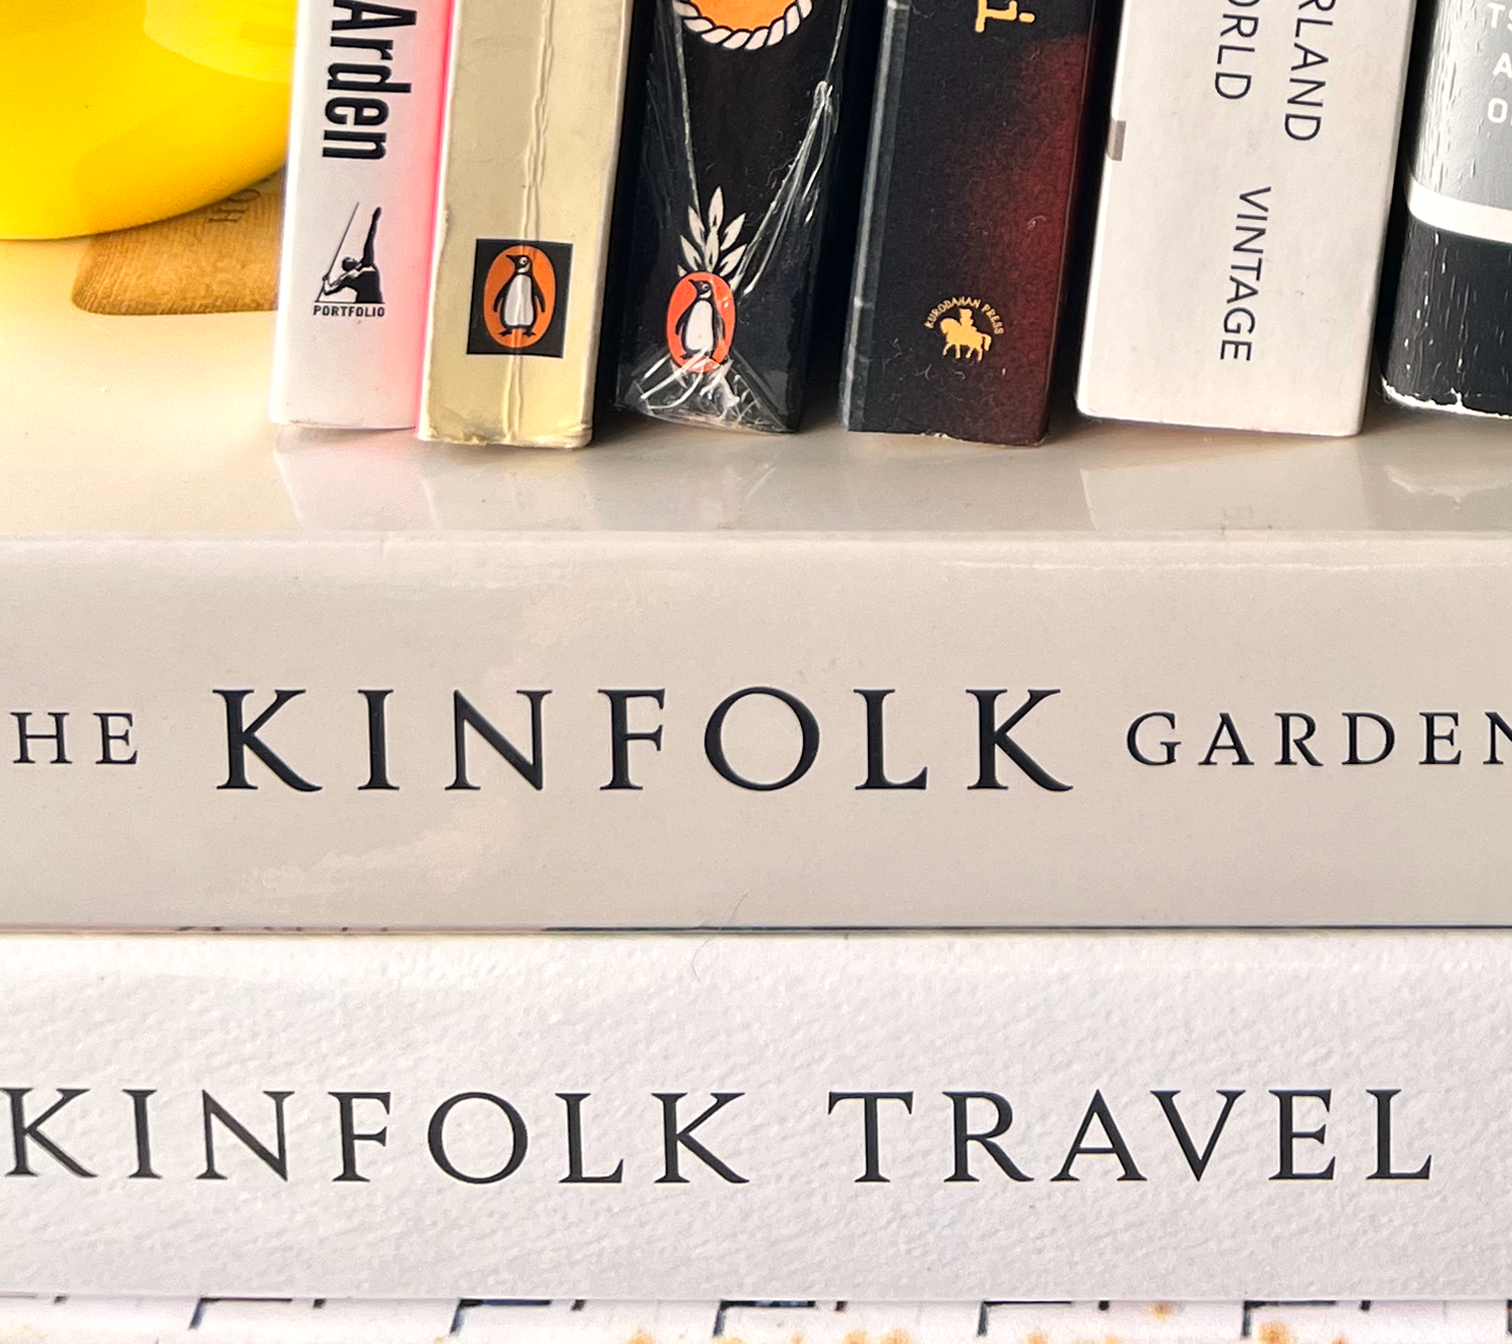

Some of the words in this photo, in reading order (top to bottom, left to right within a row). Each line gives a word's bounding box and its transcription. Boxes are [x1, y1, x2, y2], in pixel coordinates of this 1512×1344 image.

[312, 300, 386, 318] PORTFOLIO
[923, 295, 982, 330] KURODAHAN
[981, 303, 1005, 335] PRESS
[1219, 186, 1272, 362] VINTAGE
[212, 687, 1074, 793] KINFOLK
[0, 1087, 750, 1185] KINFOLK
[827, 1088, 1432, 1183] TRAVEL
